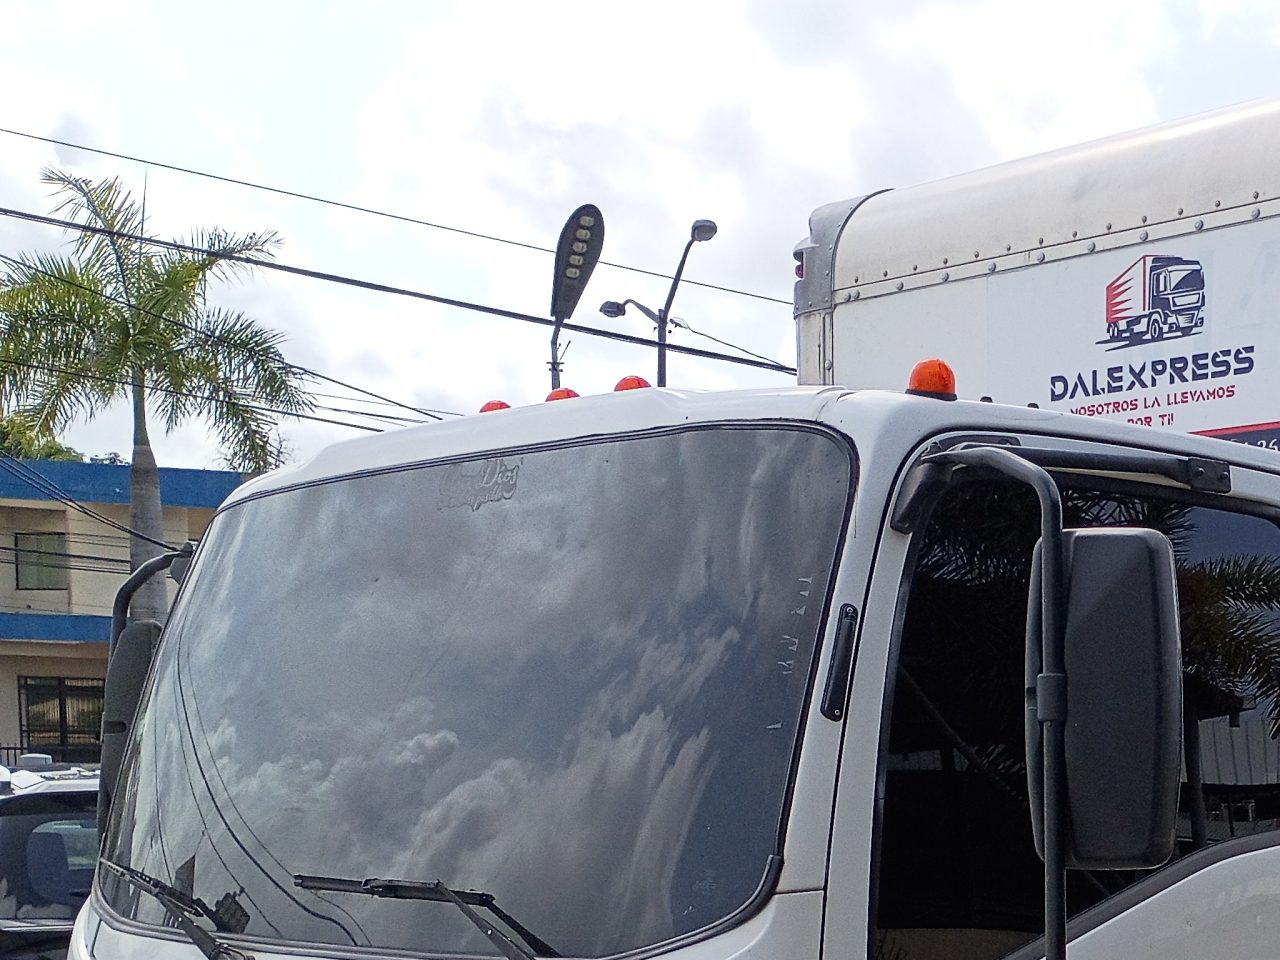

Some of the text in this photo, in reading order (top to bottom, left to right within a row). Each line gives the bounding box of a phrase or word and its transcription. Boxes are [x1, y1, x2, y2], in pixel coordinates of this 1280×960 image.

[1050, 346, 1255, 402] DALEXPRESS
[1143, 396, 1161, 409] LA
[1167, 385, 1236, 406] LLEVAMOS
